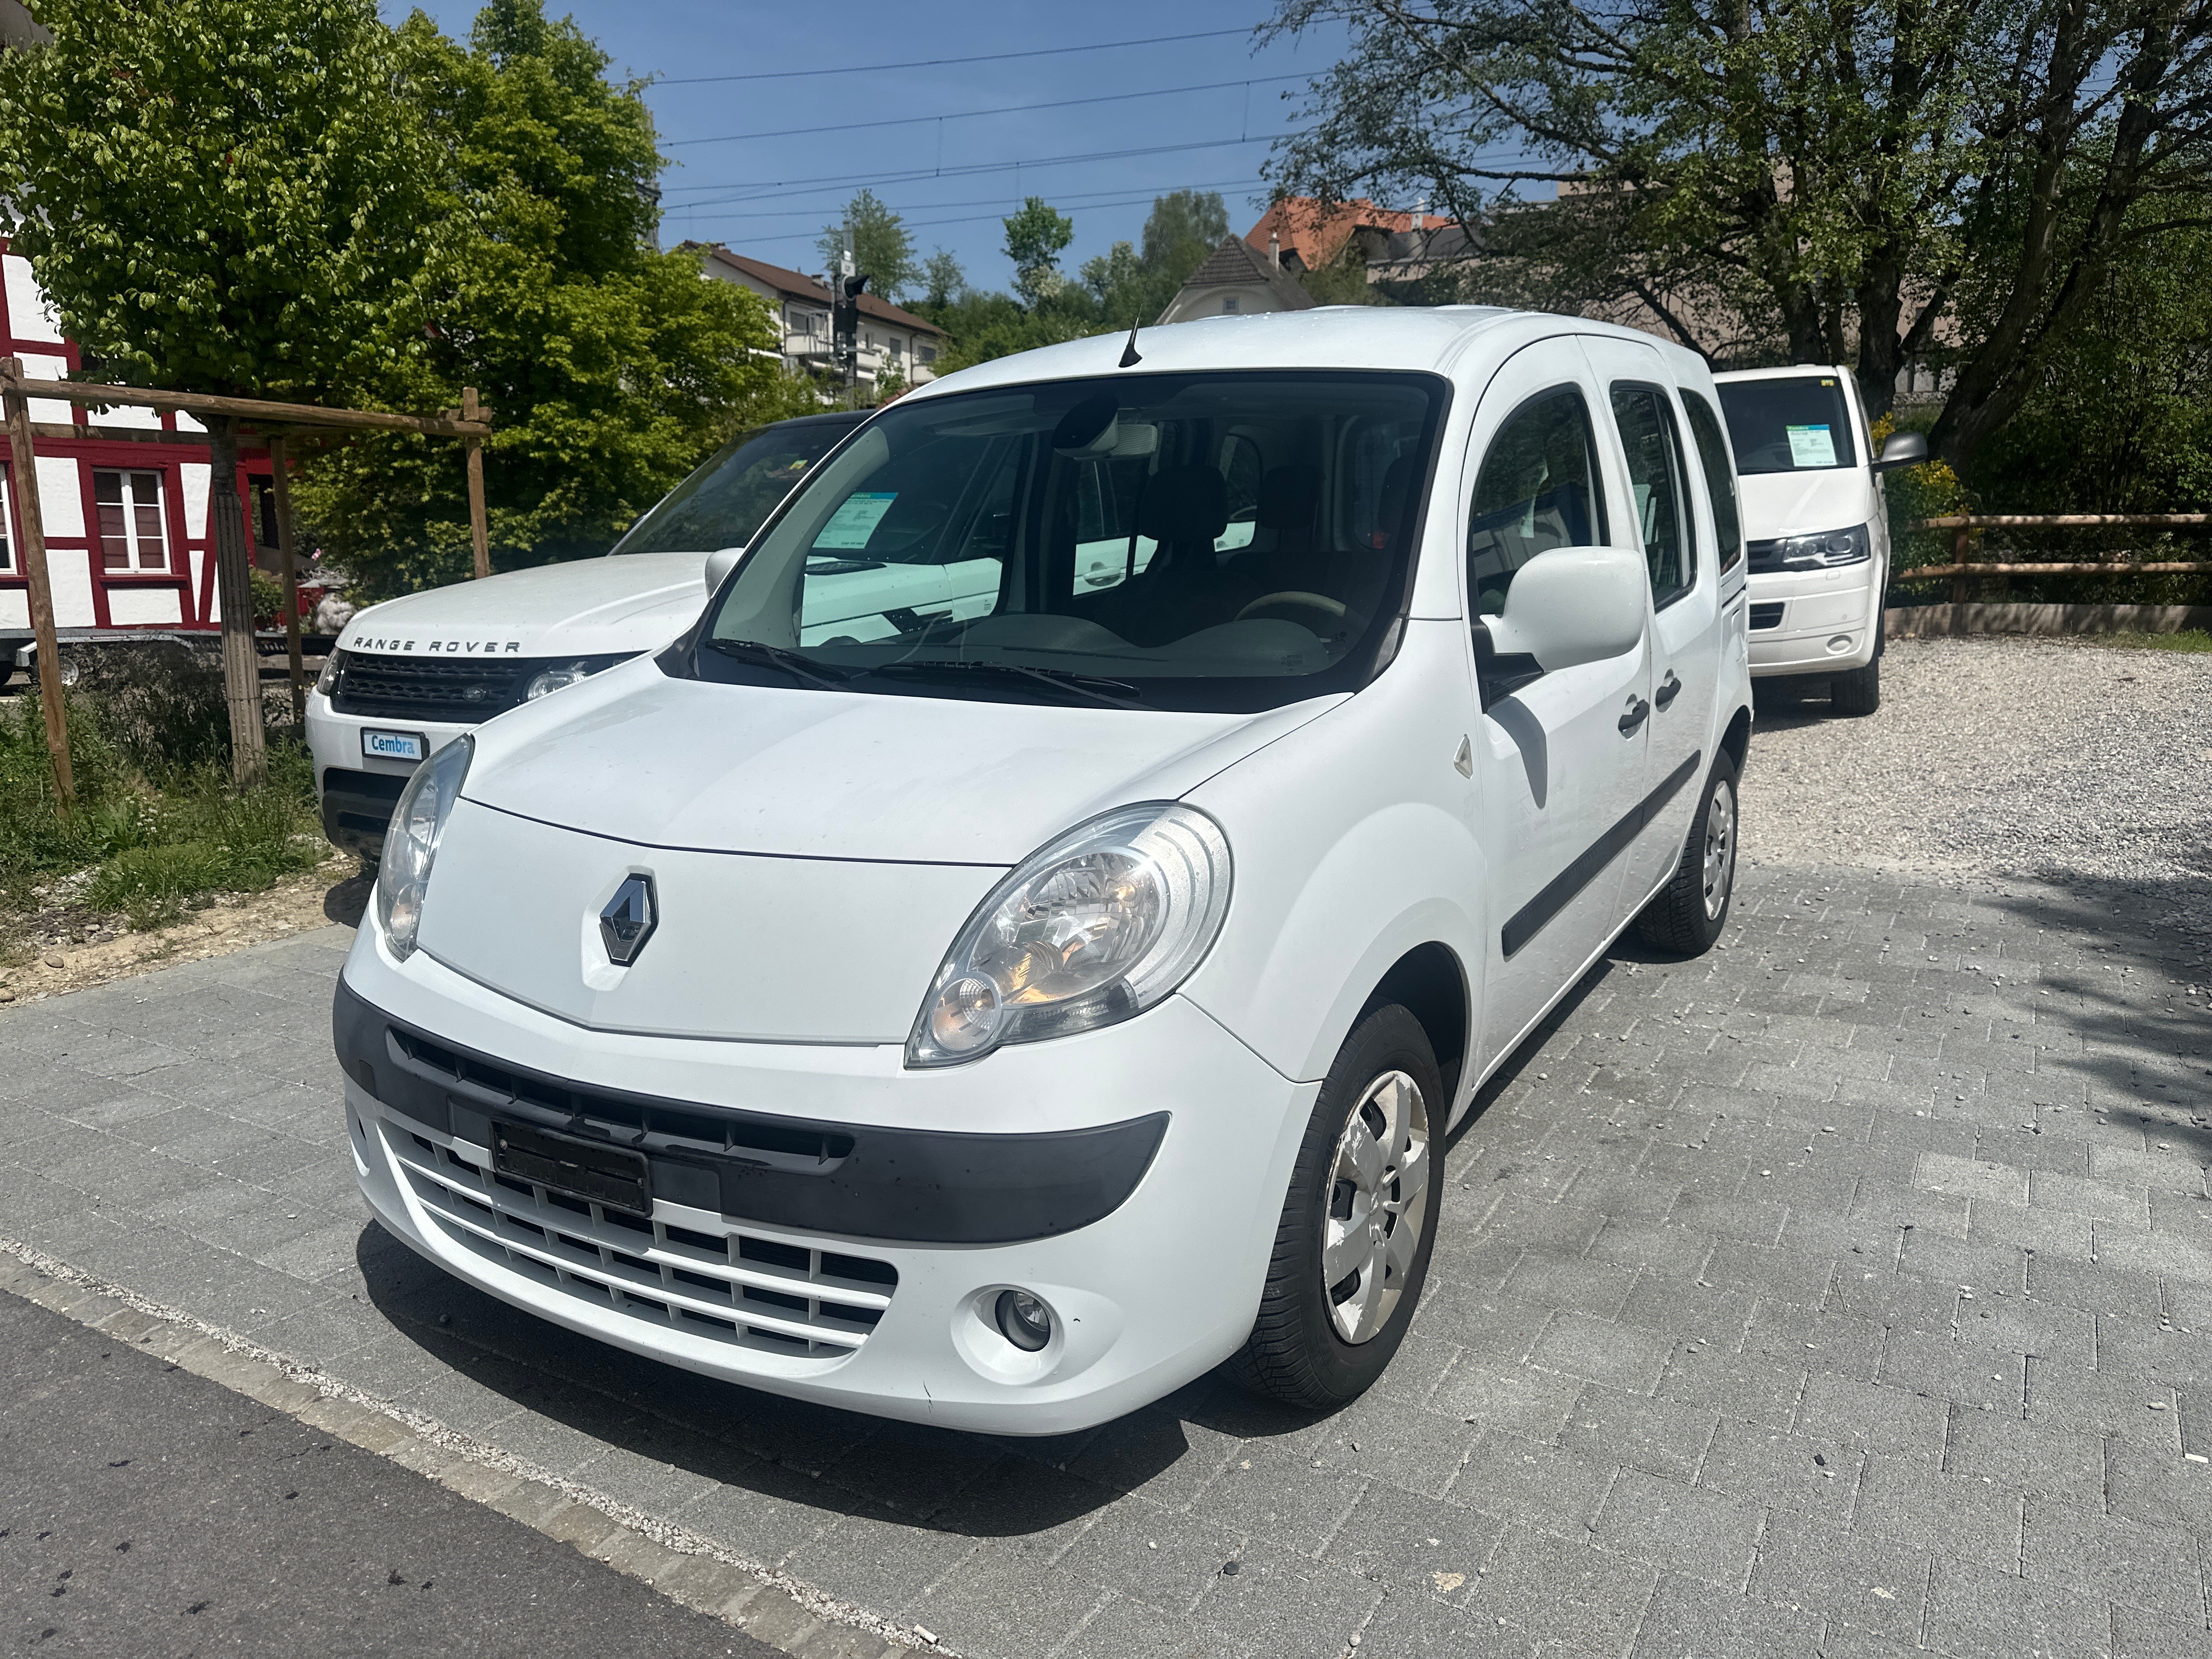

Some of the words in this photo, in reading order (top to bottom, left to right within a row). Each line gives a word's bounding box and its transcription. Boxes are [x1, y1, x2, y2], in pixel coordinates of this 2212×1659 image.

[354, 637, 415, 651] RANGE
[428, 641, 521, 653] ROVER
[371, 735, 415, 754] Cembra
